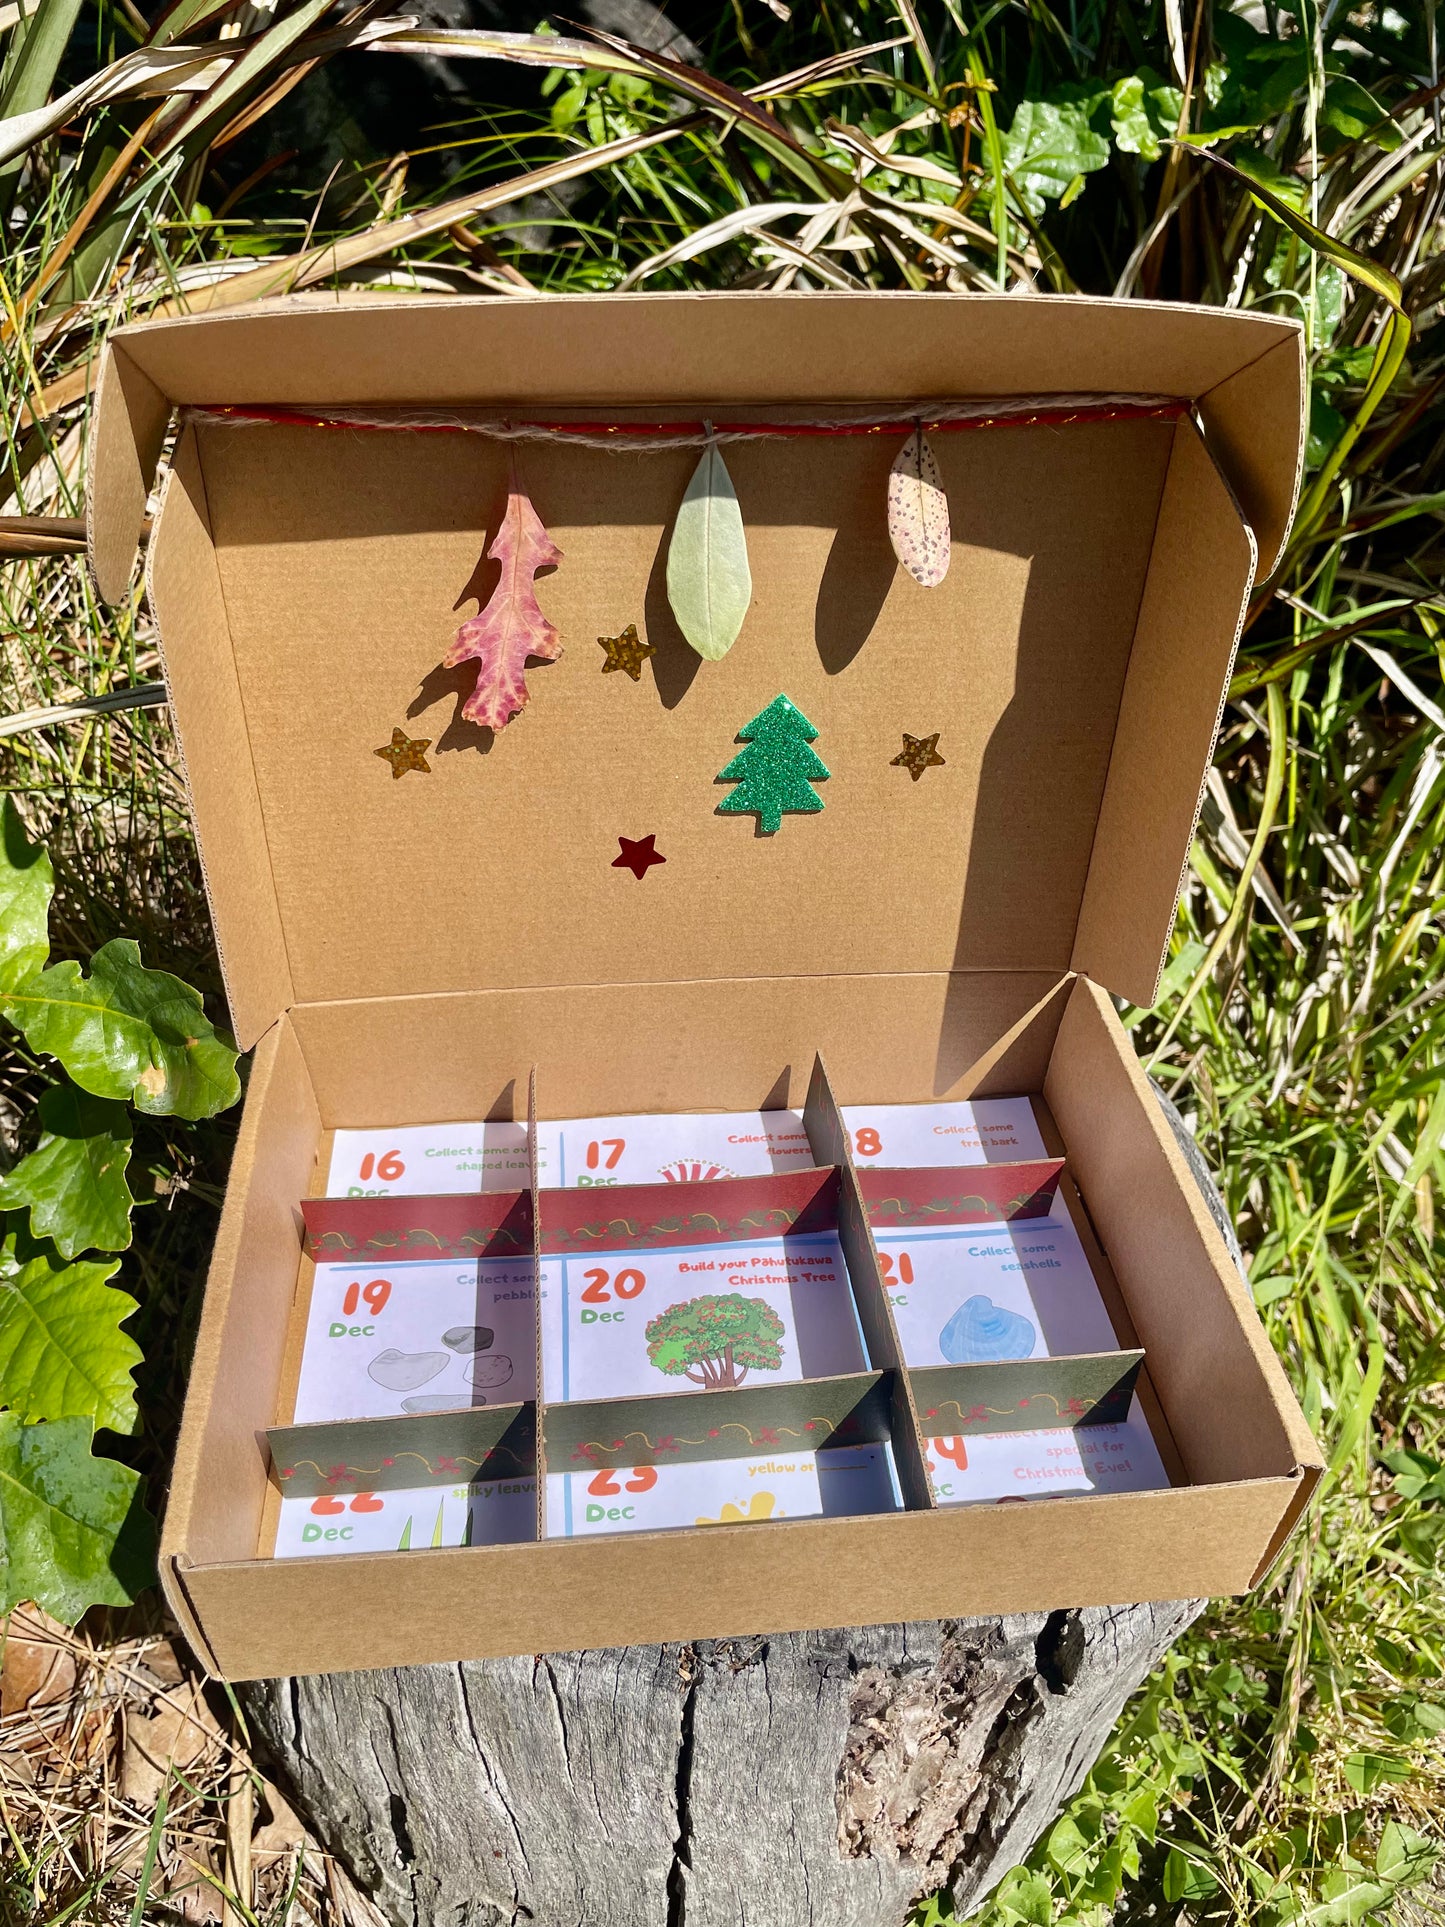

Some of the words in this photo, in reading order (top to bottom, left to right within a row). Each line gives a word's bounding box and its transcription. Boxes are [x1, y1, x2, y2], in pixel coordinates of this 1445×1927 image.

[932, 1124, 979, 1135] Collect
[982, 1122, 1014, 1132] some
[727, 1133, 774, 1145] Collect
[777, 1133, 808, 1142] some
[960, 1138, 989, 1149] tree
[990, 1136, 1020, 1147] bark
[424, 1146, 474, 1158] Collect
[476, 1145, 510, 1155] some
[512, 1144, 548, 1155] ov-
[586, 1138, 626, 1170] 17
[765, 1147, 813, 1156] flowers
[359, 1149, 406, 1182] 16
[455, 1161, 503, 1172] shaped
[505, 1159, 548, 1170] leavs
[577, 1175, 619, 1187] Dec
[967, 1244, 1018, 1258] Collect
[1021, 1243, 1056, 1254] some
[678, 1261, 715, 1273] Build
[718, 1260, 748, 1272] your
[877, 1252, 914, 1287] 21
[1000, 1258, 1061, 1272] seashells
[456, 1273, 509, 1285] Collect
[580, 1268, 647, 1304] 20
[728, 1273, 799, 1286] Christmas
[802, 1272, 836, 1283] Tree
[342, 1279, 393, 1316] 19
[493, 1289, 549, 1304] pebbls
[889, 1294, 908, 1307] ec
[580, 1309, 626, 1325] Dec
[328, 1322, 376, 1338] Dec
[1046, 1441, 1098, 1458] special
[1103, 1441, 1126, 1453] for
[748, 1463, 796, 1477] yellow
[800, 1464, 814, 1473] or
[1013, 1466, 1092, 1480] Christmas
[1094, 1460, 1134, 1474] Eve!
[452, 1482, 493, 1500] spiky
[933, 1483, 956, 1497] ec
[586, 1503, 636, 1523] Dec
[301, 1522, 354, 1543] Dec
